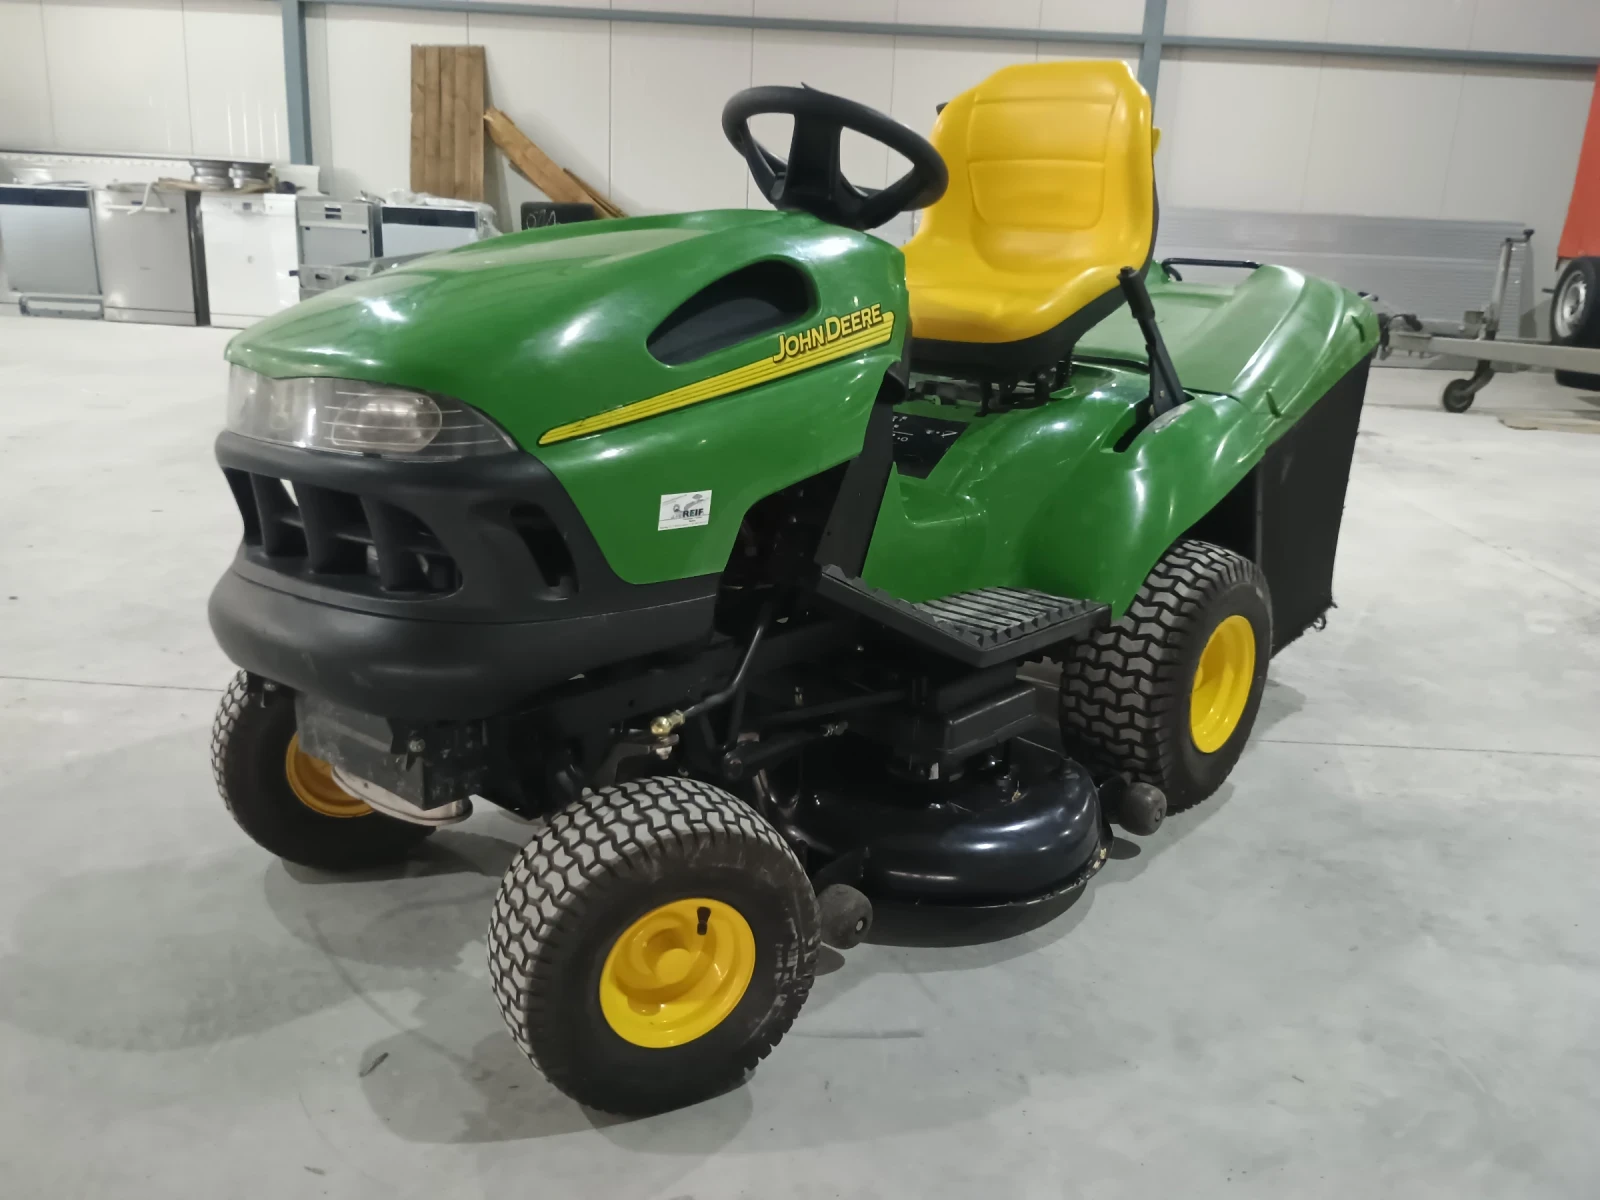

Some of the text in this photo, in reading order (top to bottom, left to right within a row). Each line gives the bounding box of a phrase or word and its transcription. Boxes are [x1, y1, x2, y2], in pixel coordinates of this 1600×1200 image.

[773, 303, 882, 362] JOHN DEERE
[683, 508, 704, 518] REIF
